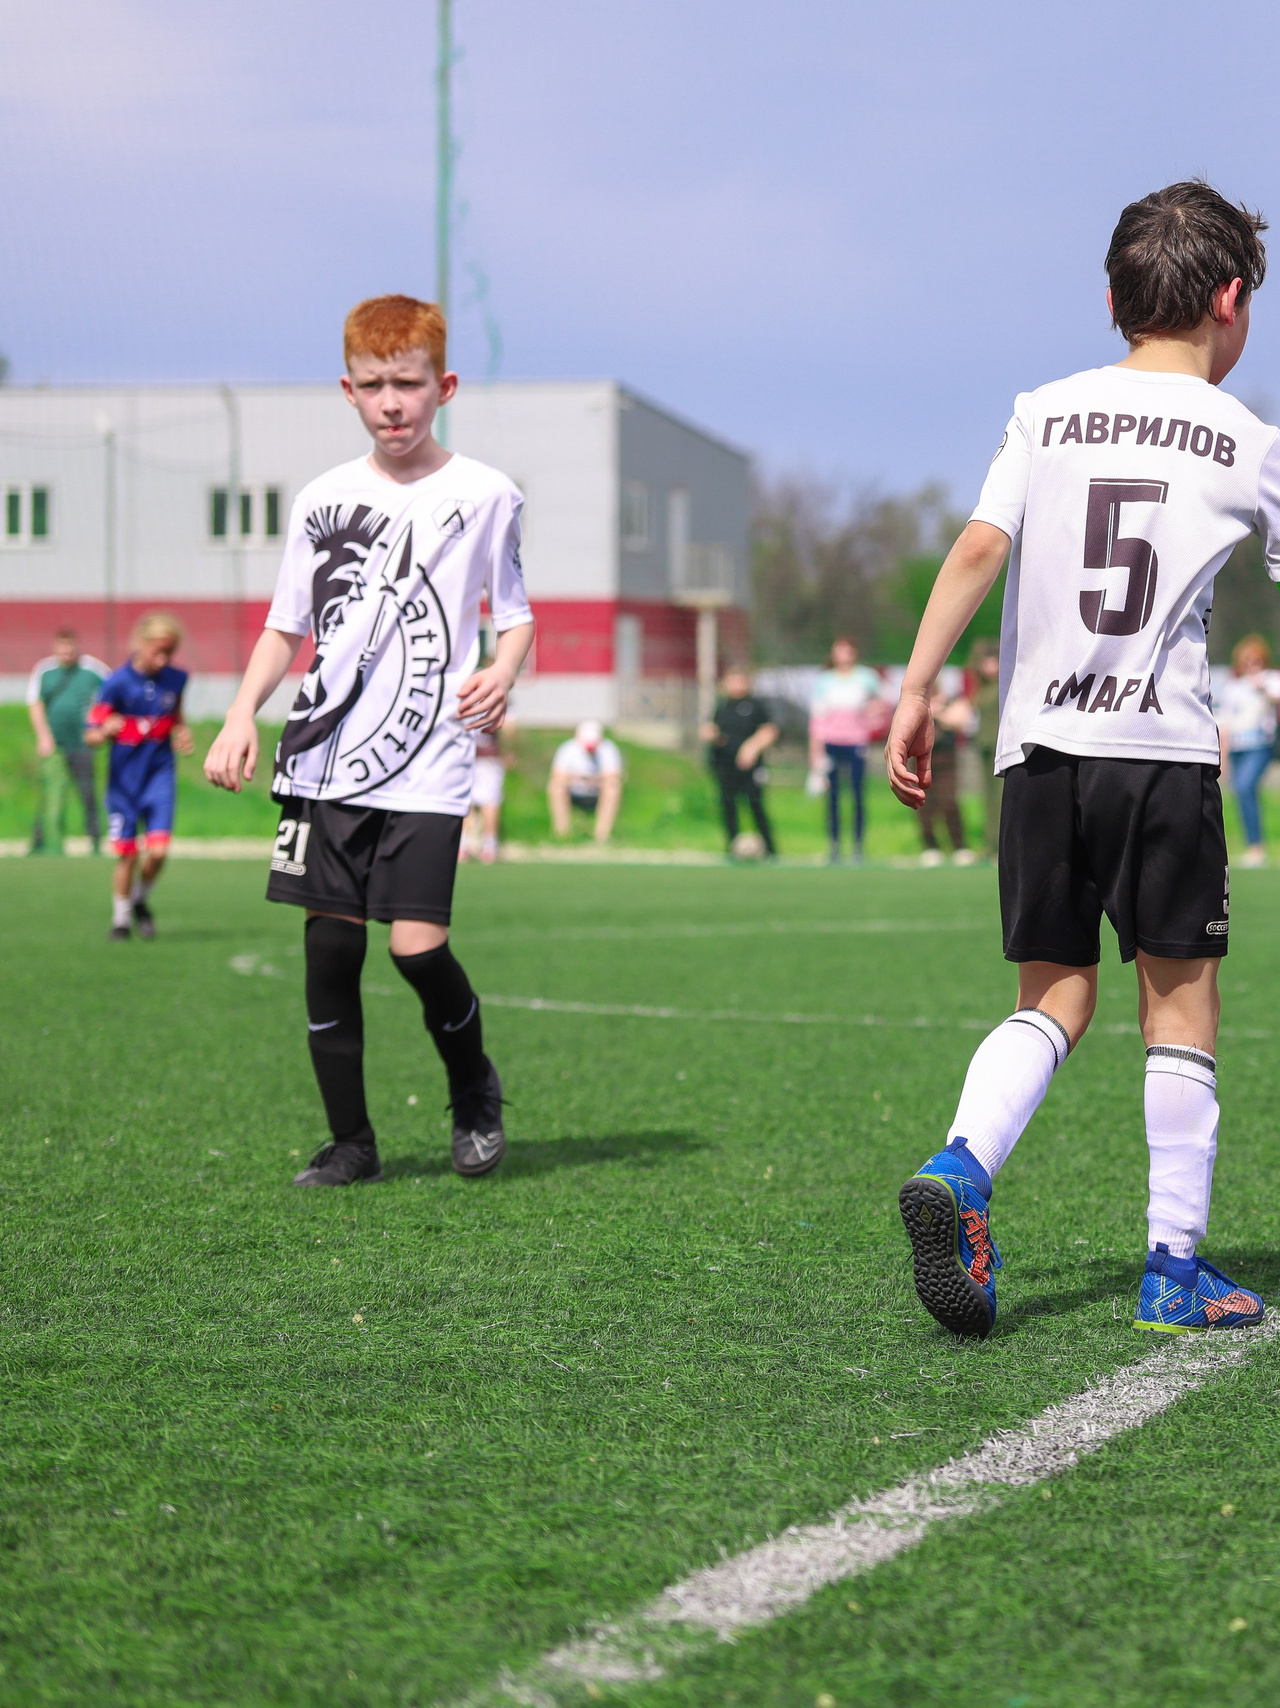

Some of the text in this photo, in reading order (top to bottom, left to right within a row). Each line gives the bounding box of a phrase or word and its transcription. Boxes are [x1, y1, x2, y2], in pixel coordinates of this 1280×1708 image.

[1042, 412, 1236, 468] ГАВРИЛОВ
[1079, 478, 1169, 637] 5
[272, 819, 311, 863] 21
